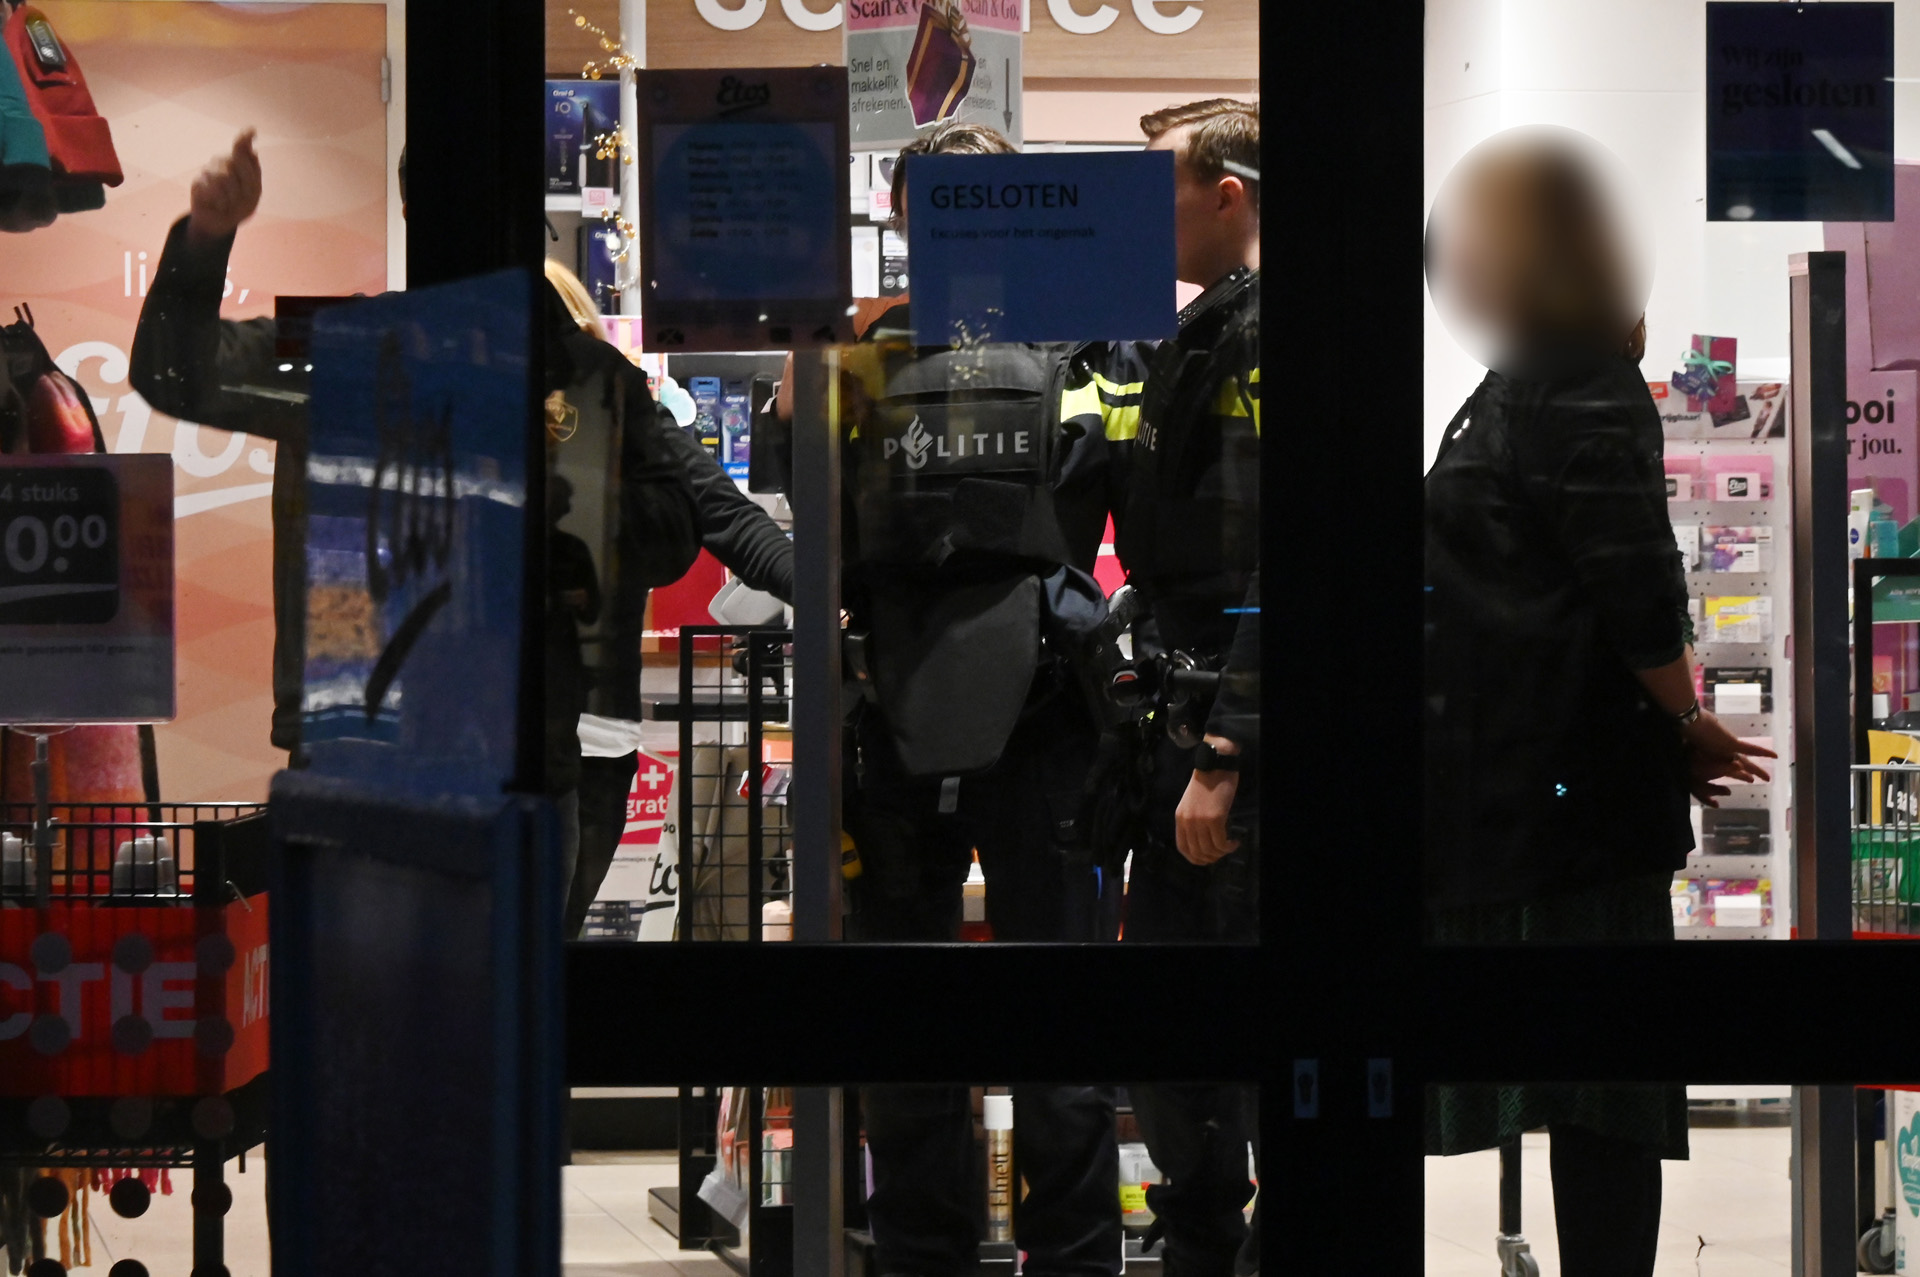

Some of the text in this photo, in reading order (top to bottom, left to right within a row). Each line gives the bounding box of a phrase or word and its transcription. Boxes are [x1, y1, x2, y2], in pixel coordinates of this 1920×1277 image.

[851, 57, 890, 73] Snel en
[1764, 46, 1804, 70] zijn
[716, 75, 771, 107] Etos
[851, 75, 899, 94] makkelijk
[1722, 72, 1878, 116] gesloten
[851, 97, 907, 113] afrekenen.
[930, 184, 1079, 210] GESLOTEN
[930, 228, 978, 240] Excuses
[1014, 227, 1034, 239] het
[1038, 227, 1096, 241] ongemak
[1859, 433, 1902, 461] jou.
[20, 484, 80, 503] stuks
